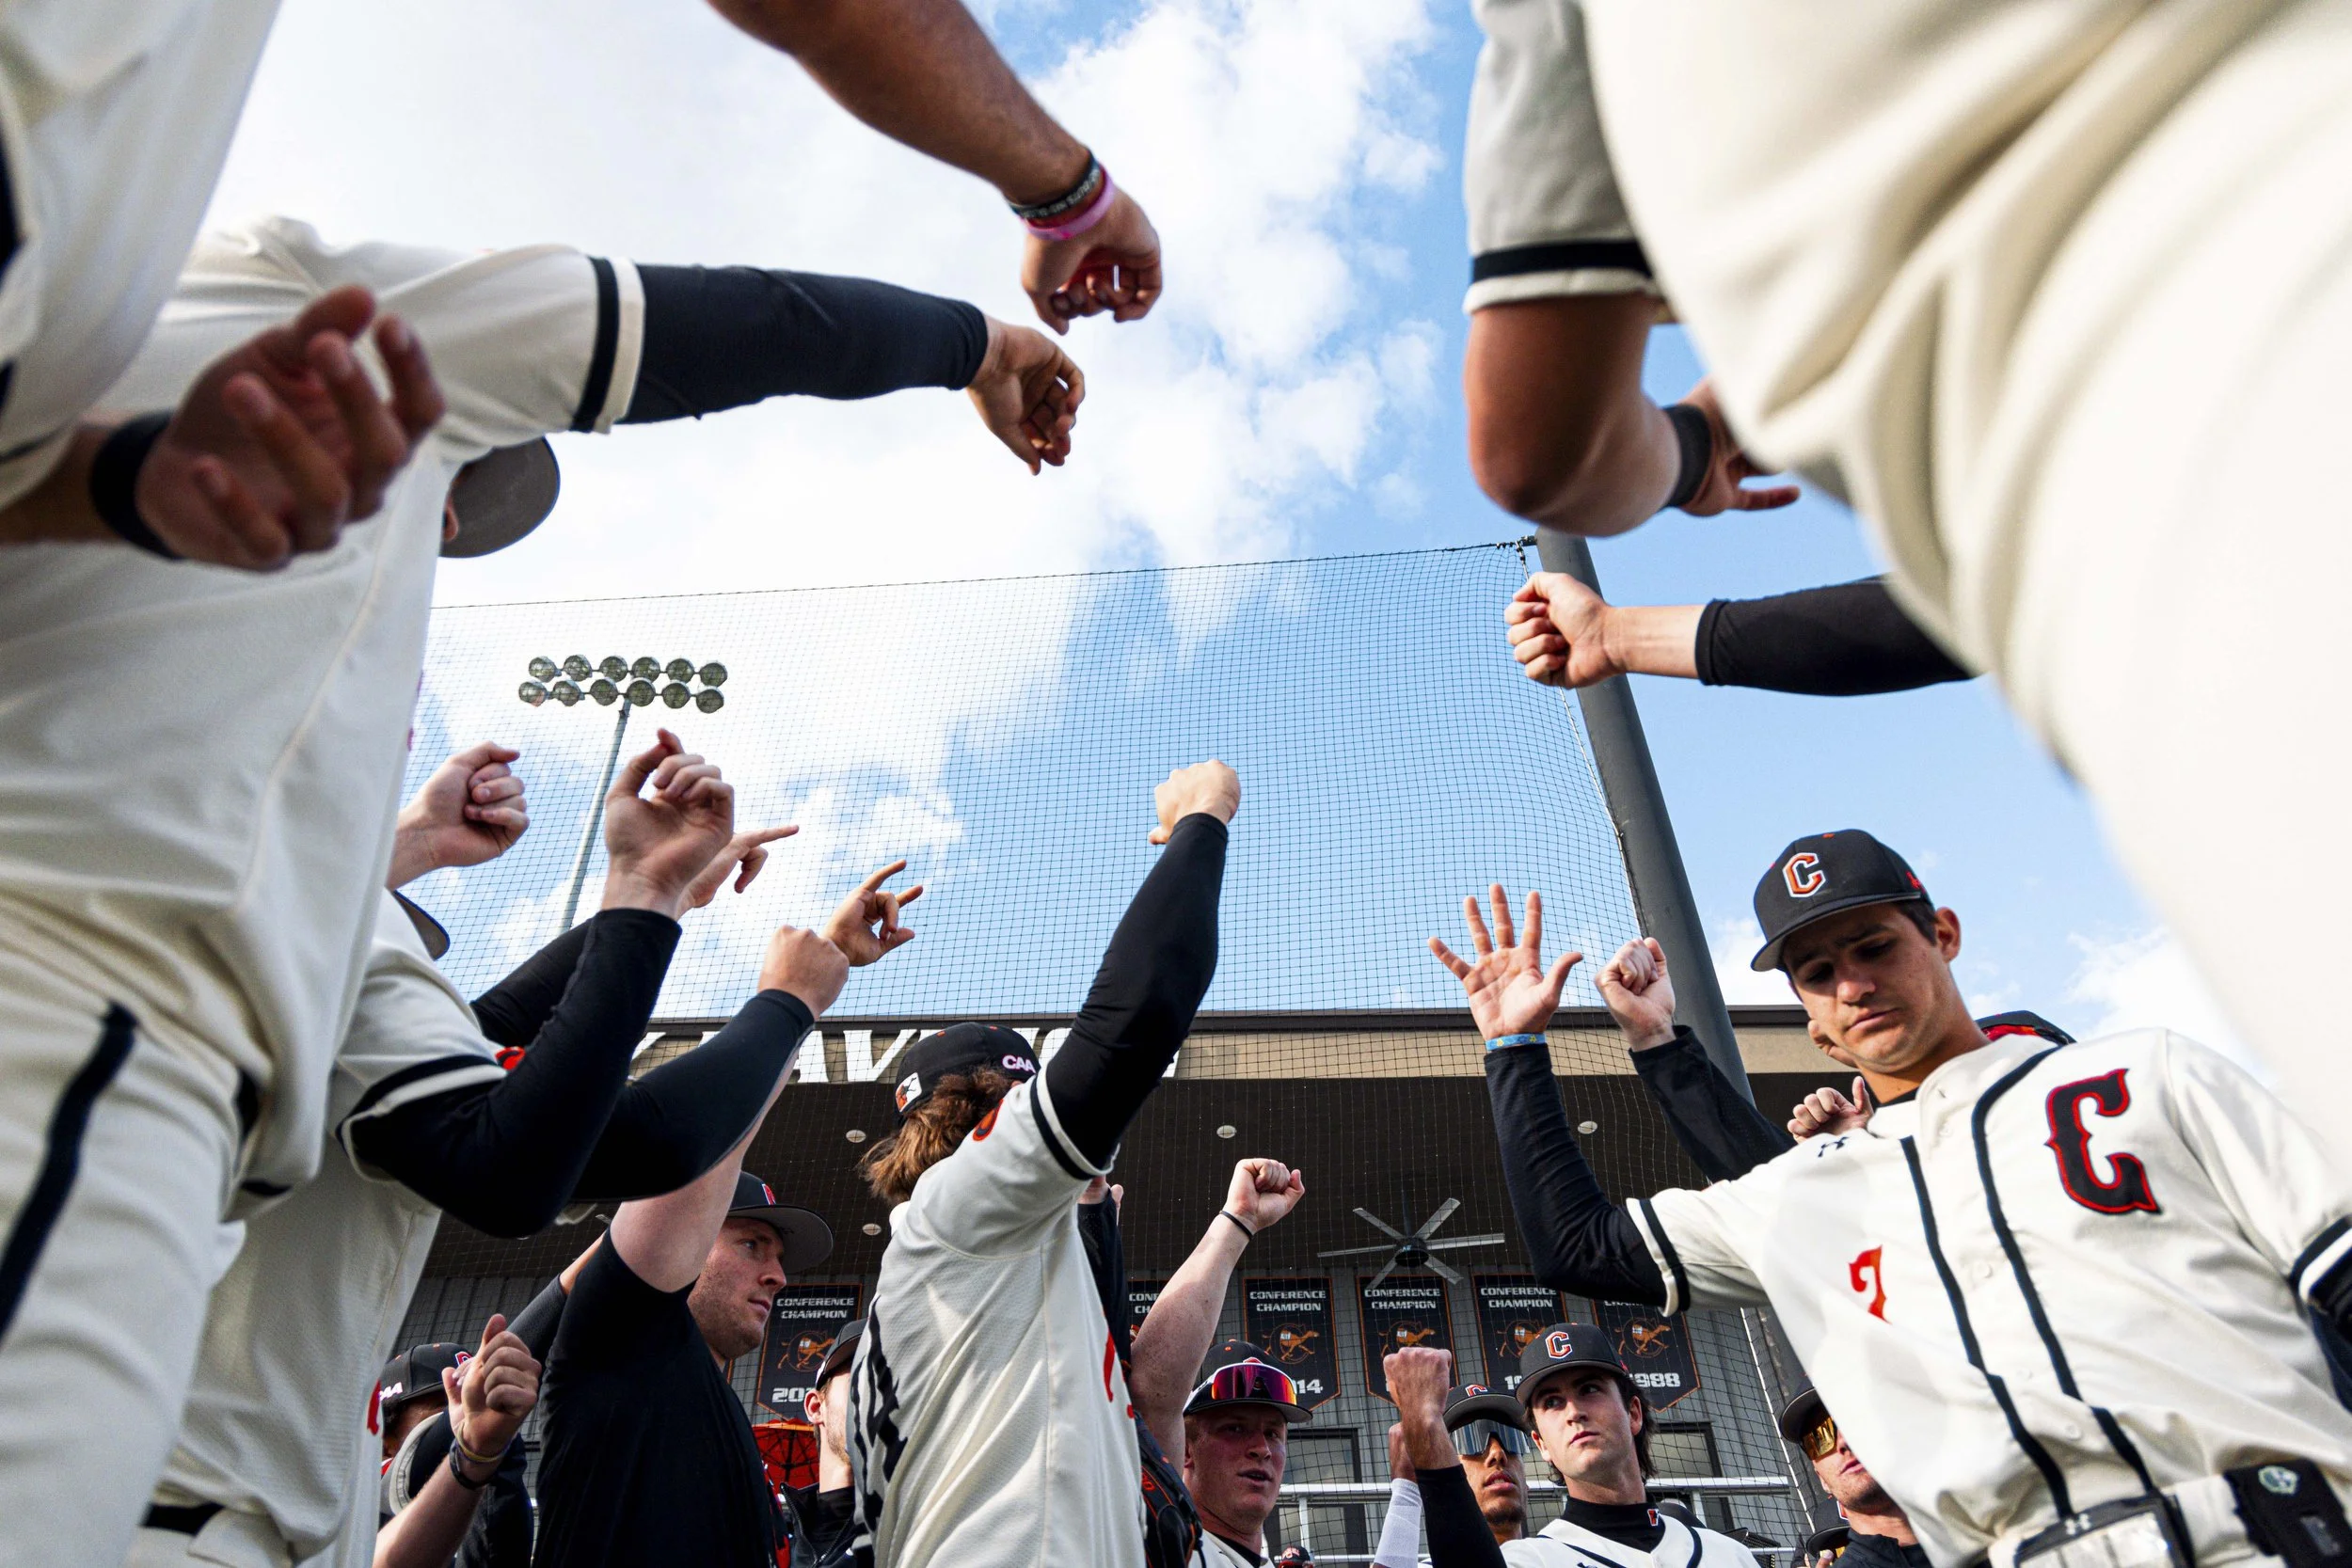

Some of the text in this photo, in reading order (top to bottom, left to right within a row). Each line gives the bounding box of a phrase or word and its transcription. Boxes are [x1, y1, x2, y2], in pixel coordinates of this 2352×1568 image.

[1782, 852, 1826, 897] C
[1001, 1054, 1036, 1073] CAA
[2043, 1068, 2163, 1215] C
[1848, 1243, 1892, 1325] 7
[1249, 1291, 1327, 1300] CONFERENCE
[1364, 1288, 1441, 1298] CONFERENCE
[1480, 1287, 1557, 1296] CONFERENCE
[776, 1297, 854, 1307] CONFERENCE
[1371, 1300, 1437, 1310] CHAMPION
[1488, 1299, 1553, 1308] CHAMPION
[1256, 1303, 1322, 1312] CHAMPION
[781, 1309, 848, 1319] CHAMPION
[1545, 1330, 1573, 1359] C
[1629, 1372, 1681, 1387] 988
